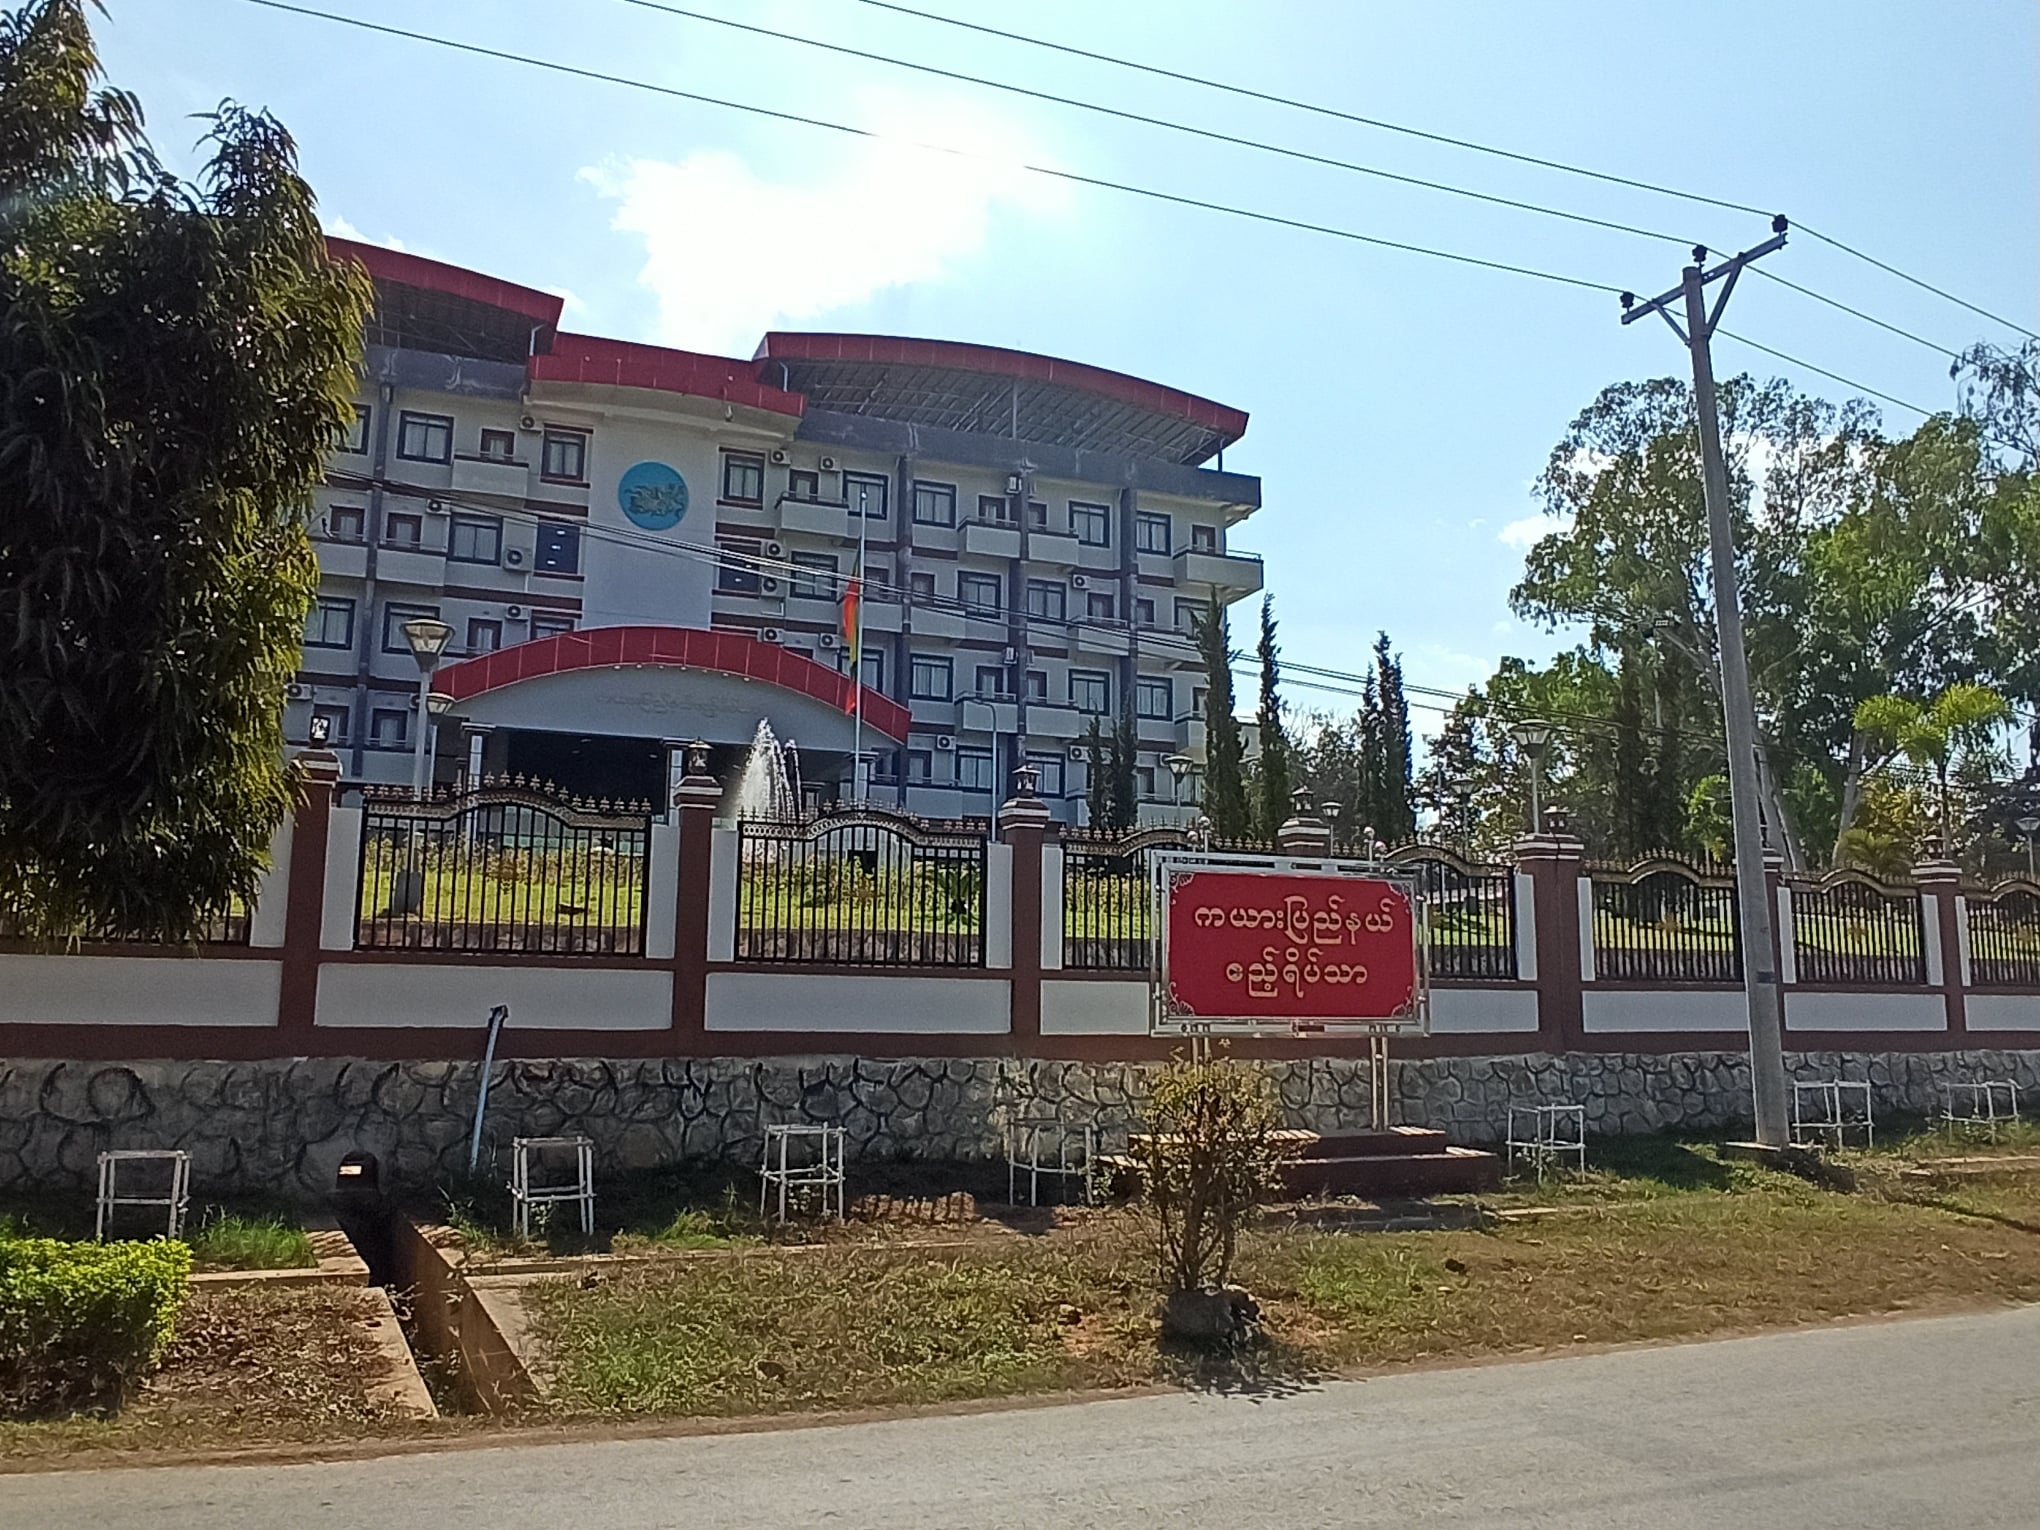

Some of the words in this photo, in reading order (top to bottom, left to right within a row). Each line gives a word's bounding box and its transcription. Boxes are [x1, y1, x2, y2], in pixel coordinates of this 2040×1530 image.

[1195, 894, 1396, 945] ကယားပြည်နယ်
